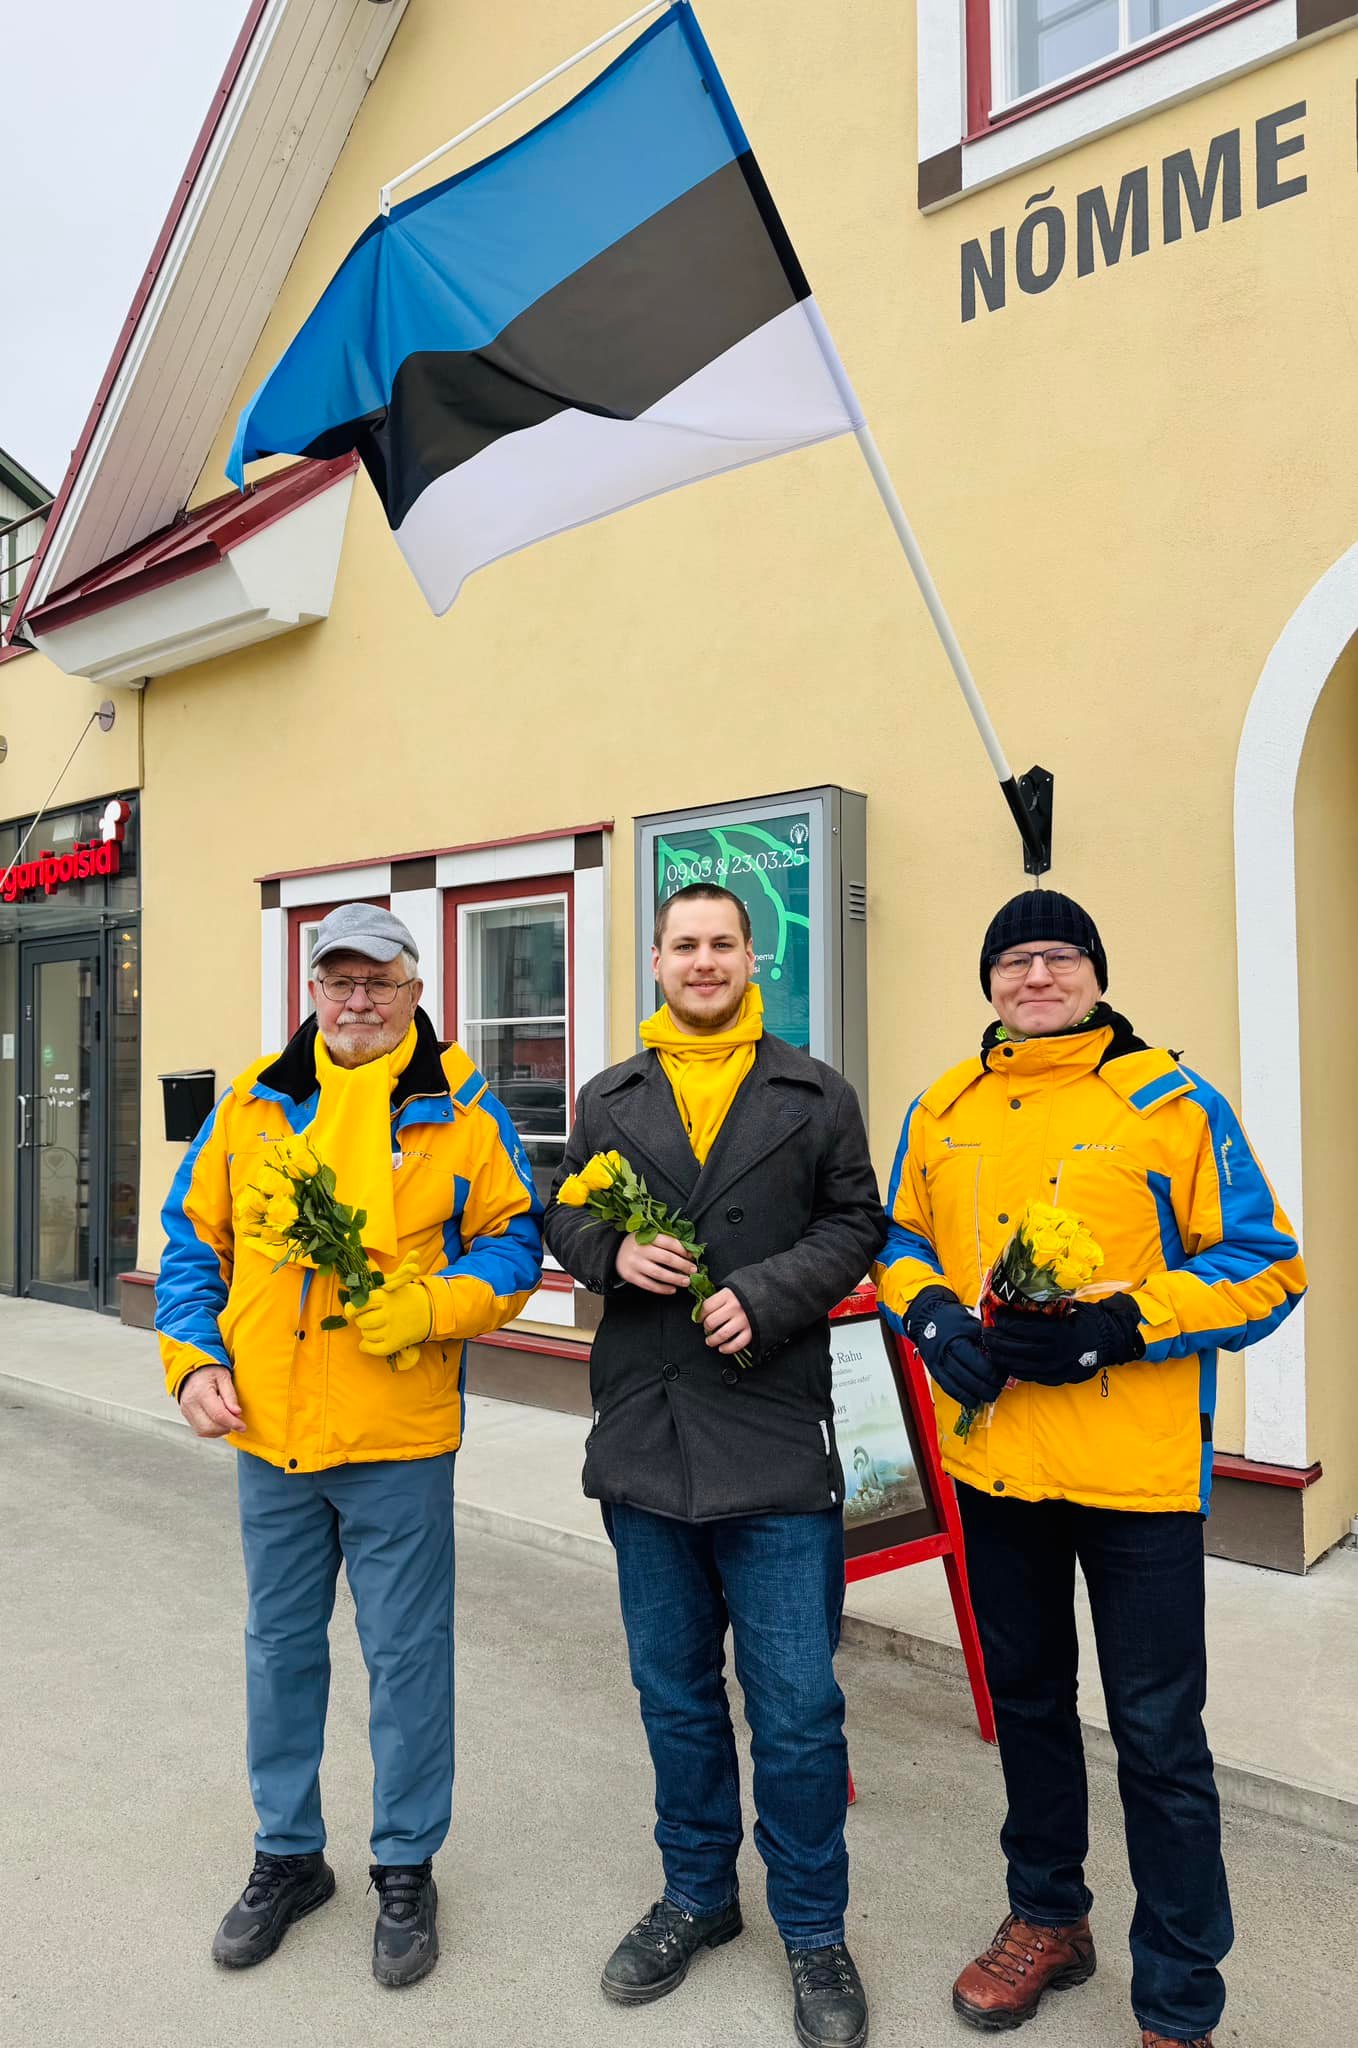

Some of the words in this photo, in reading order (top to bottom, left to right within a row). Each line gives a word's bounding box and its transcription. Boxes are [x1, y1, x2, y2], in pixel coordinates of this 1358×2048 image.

[961, 100, 1307, 323] NÕMME
[667, 860, 712, 881] 09.03
[715, 858, 728, 876] &
[732, 848, 805, 874] 23.03.25
[836, 1350, 863, 1364] Rahu
